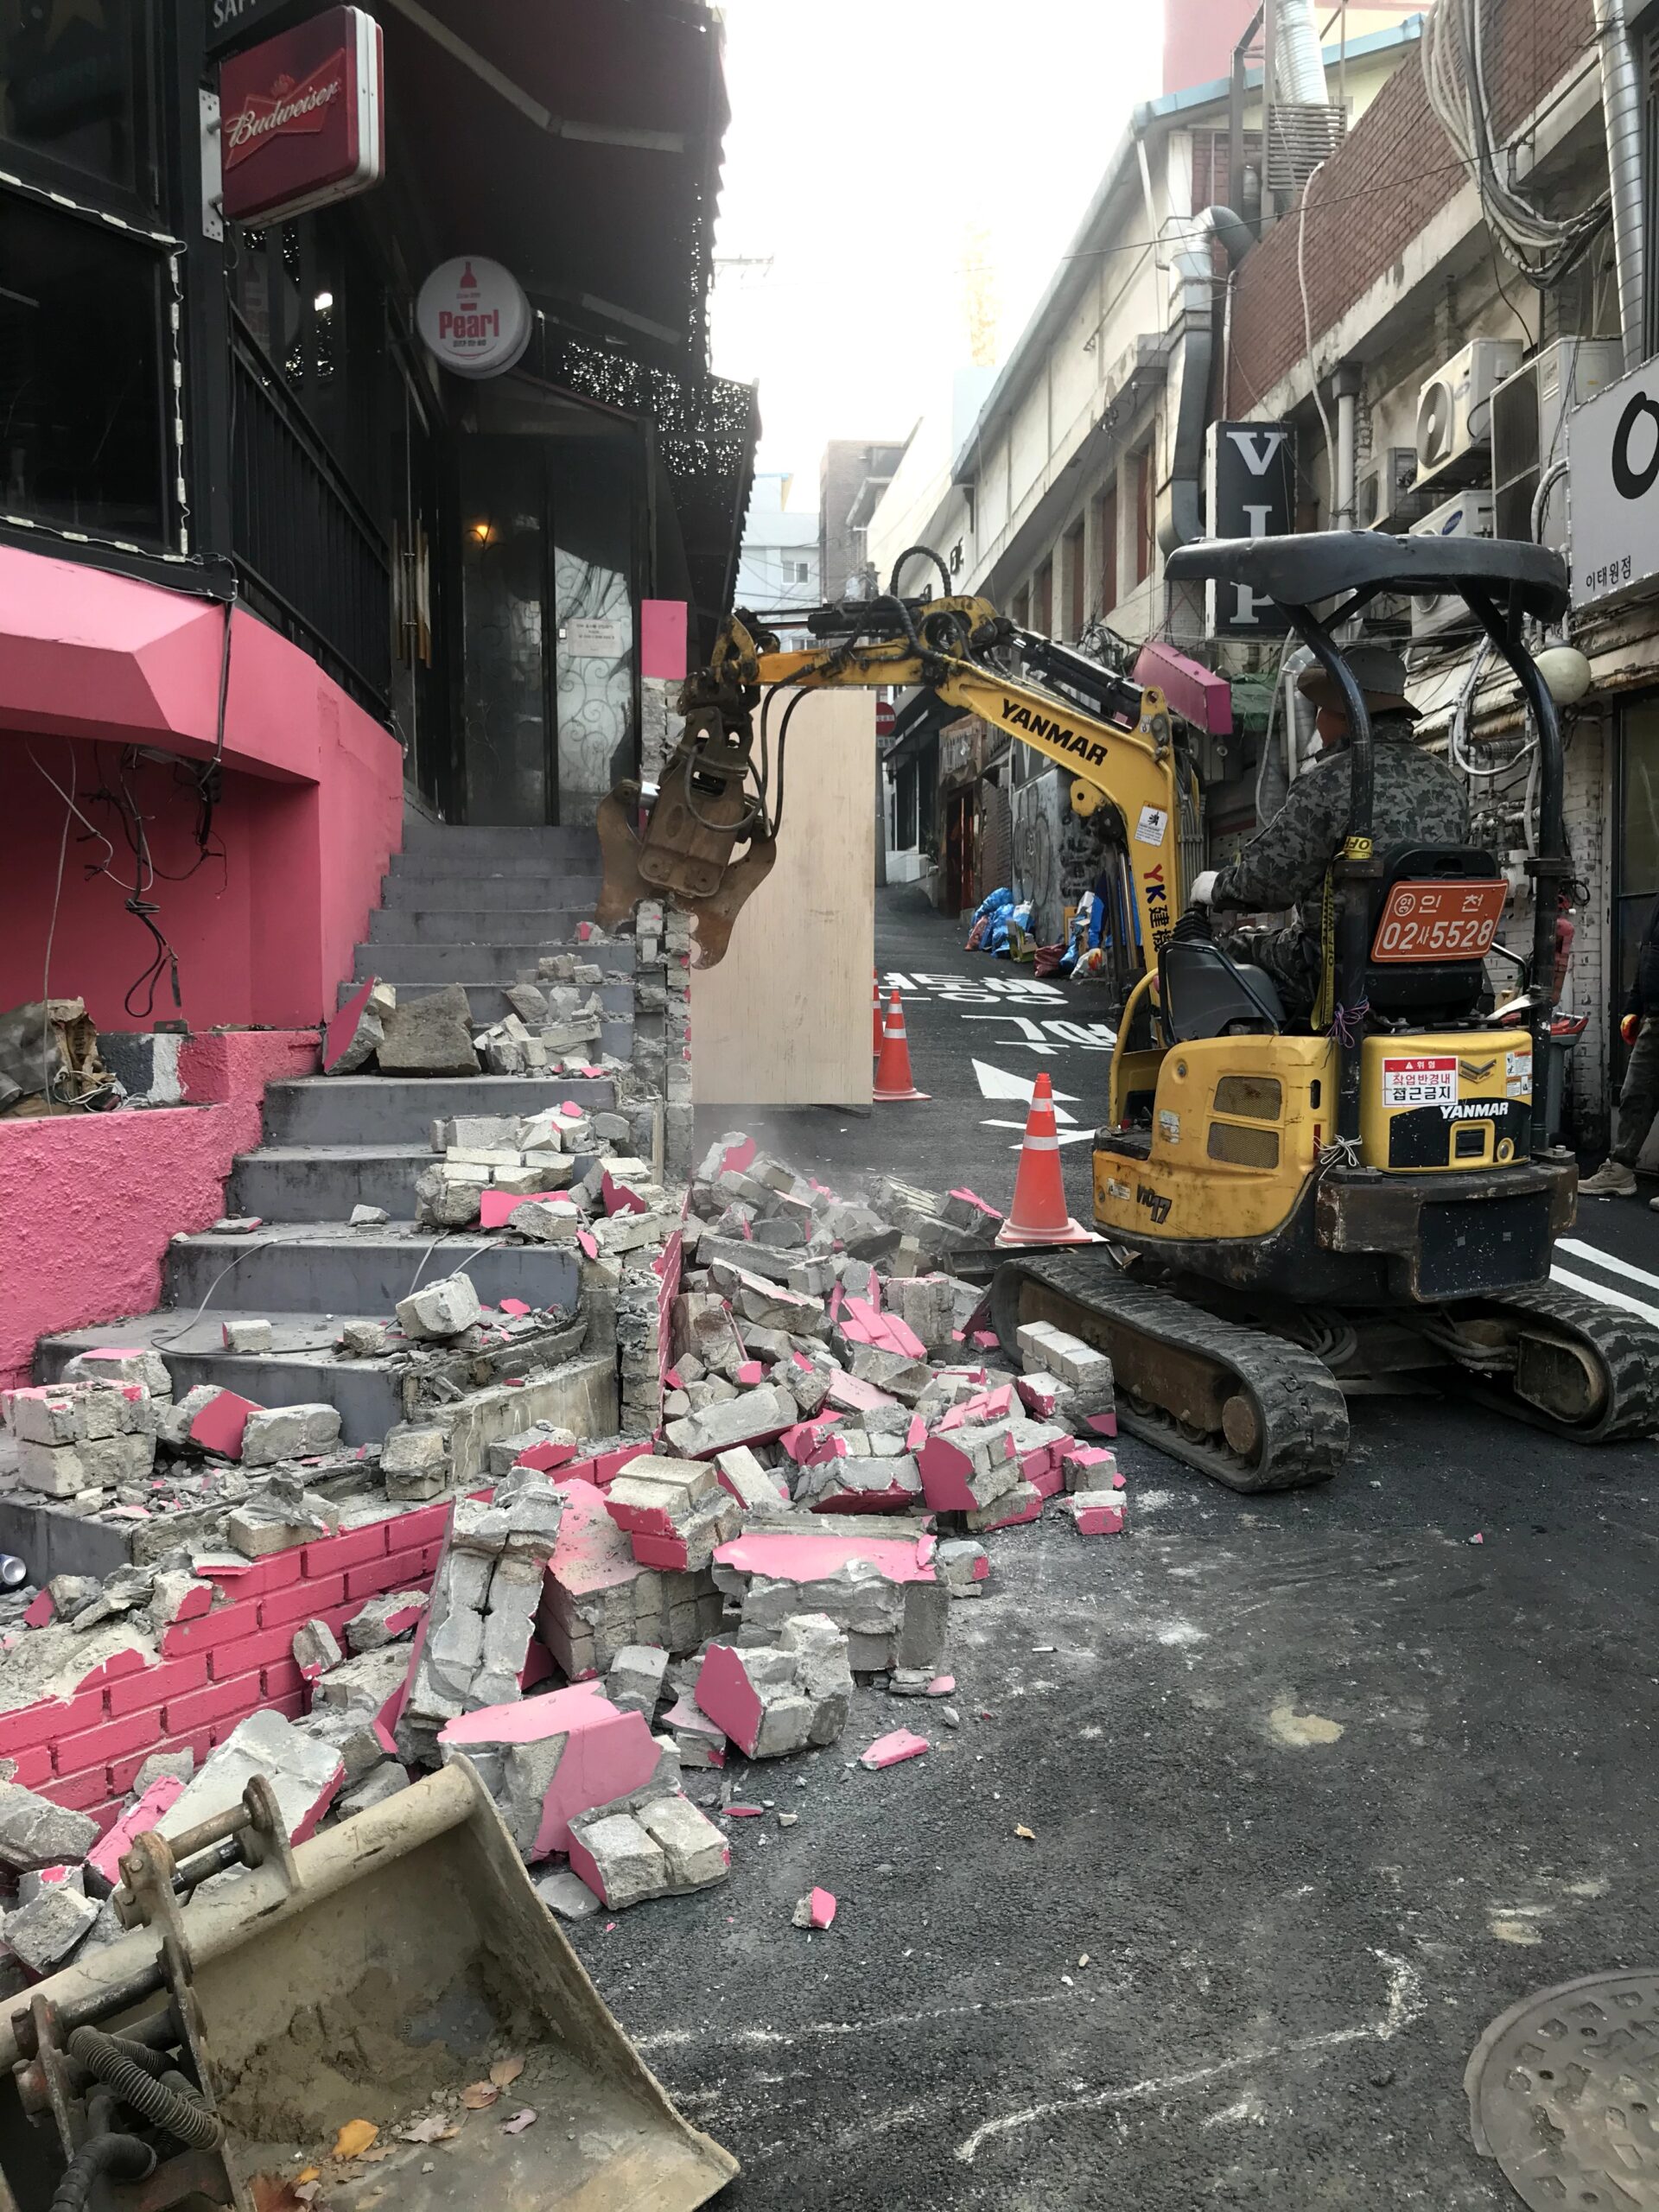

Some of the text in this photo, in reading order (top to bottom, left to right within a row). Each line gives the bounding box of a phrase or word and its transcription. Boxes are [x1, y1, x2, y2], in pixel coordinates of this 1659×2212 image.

[225, 80, 340, 148] Budweiser
[439, 309, 499, 340] Pearl
[1586, 556, 1632, 592] 이태원점
[1001, 697, 1109, 766] YANMAR
[1393, 1073, 1451, 1086] 작업반경내
[1393, 1085, 1451, 1101] 접근금지
[1440, 1102, 1509, 1120] YANMAR
